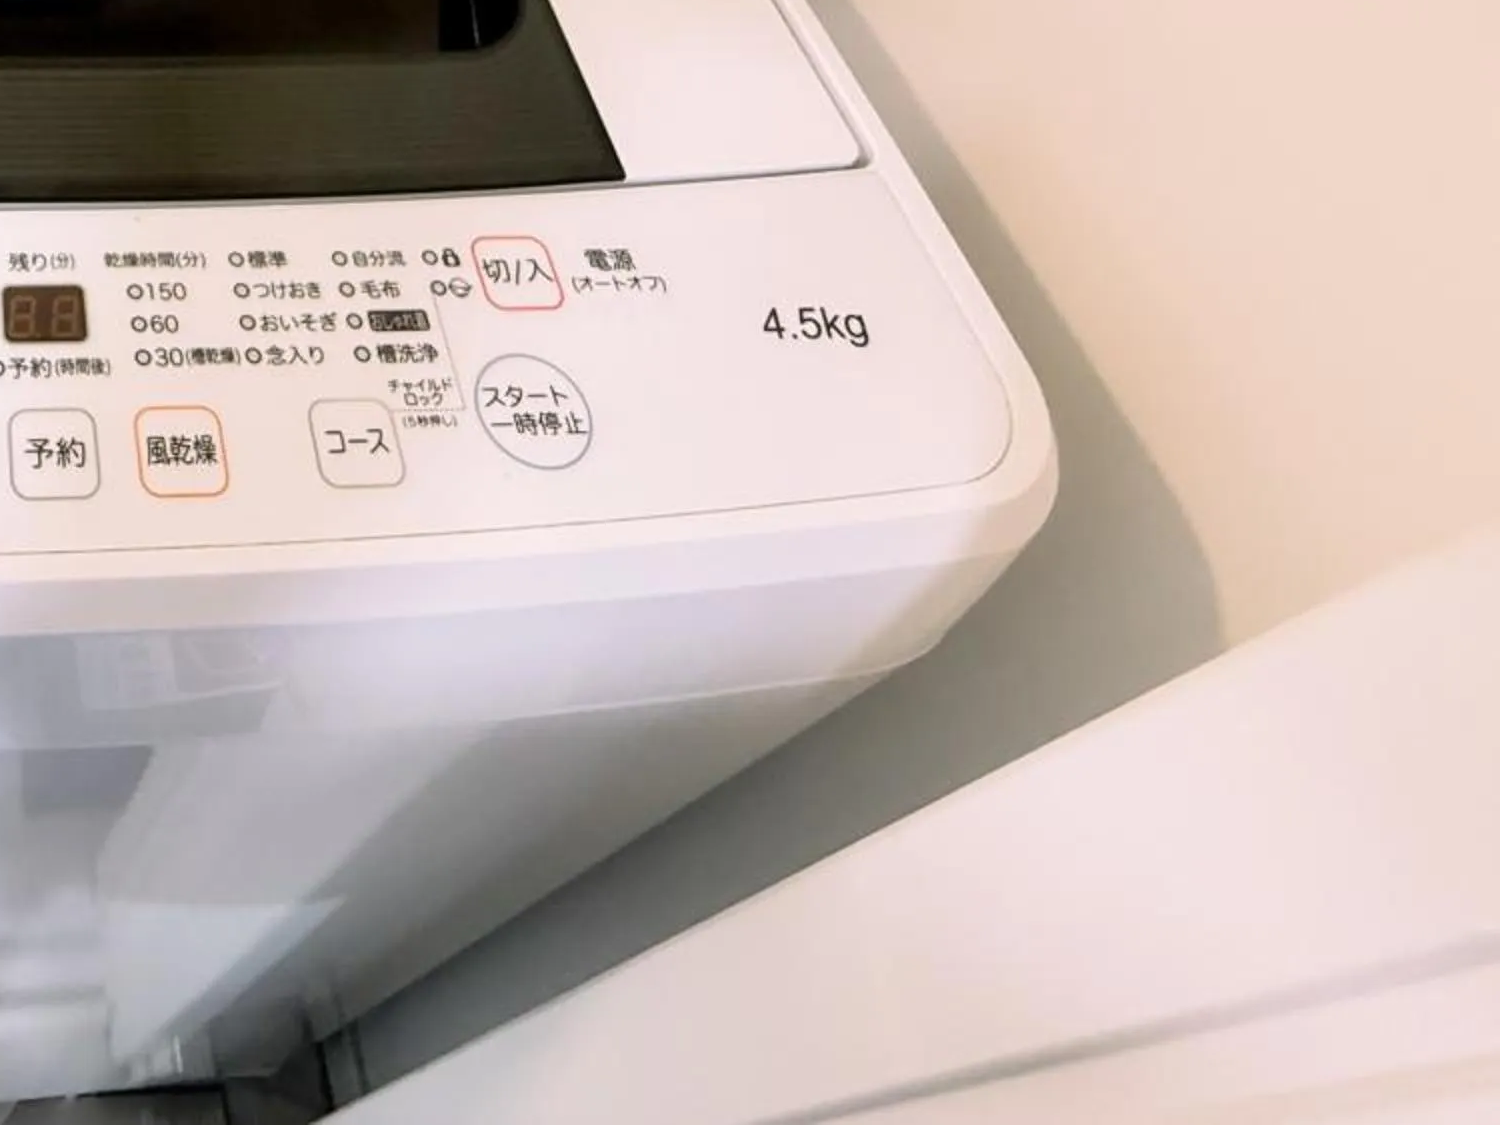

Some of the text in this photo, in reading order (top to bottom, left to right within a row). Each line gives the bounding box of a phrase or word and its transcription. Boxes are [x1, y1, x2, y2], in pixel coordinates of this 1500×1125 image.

[584, 248, 636, 271] 電源
[146, 282, 187, 301] 150
[361, 280, 401, 299] 毛布
[150, 315, 179, 334] 60
[762, 307, 869, 348] 4.5kg
[481, 385, 569, 408] スタート
[490, 411, 589, 436] 一時停止
[24, 437, 87, 469] 予約
[146, 434, 219, 467] 風乾燥
[324, 428, 391, 455] コース
